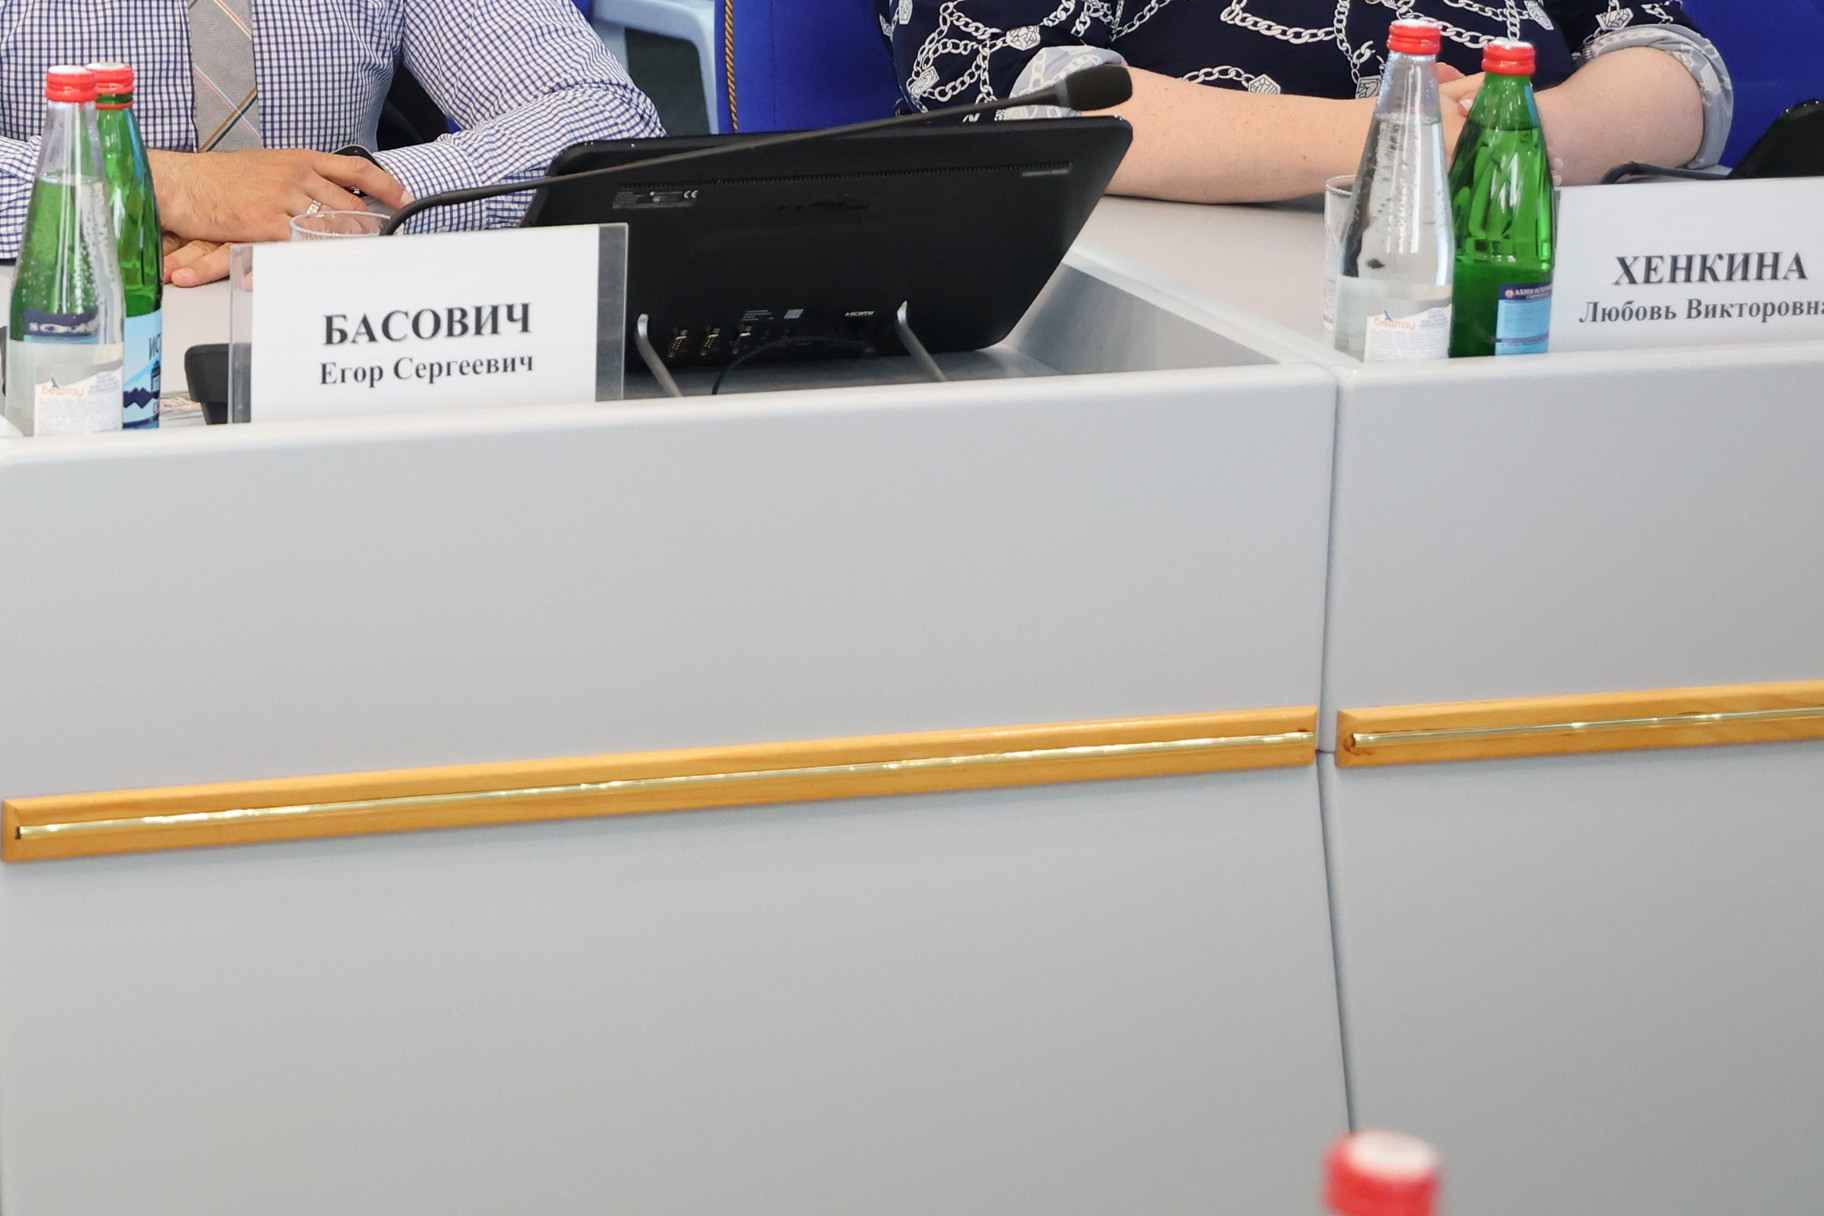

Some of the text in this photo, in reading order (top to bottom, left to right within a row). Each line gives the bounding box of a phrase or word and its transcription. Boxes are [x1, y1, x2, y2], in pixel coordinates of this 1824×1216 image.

[1614, 251, 1808, 286] ХЕНКИНА
[324, 302, 531, 346] БАСОВИЧ
[1578, 298, 1824, 324] Любовь Викторовн
[320, 355, 534, 388] Егор Сергеевич
